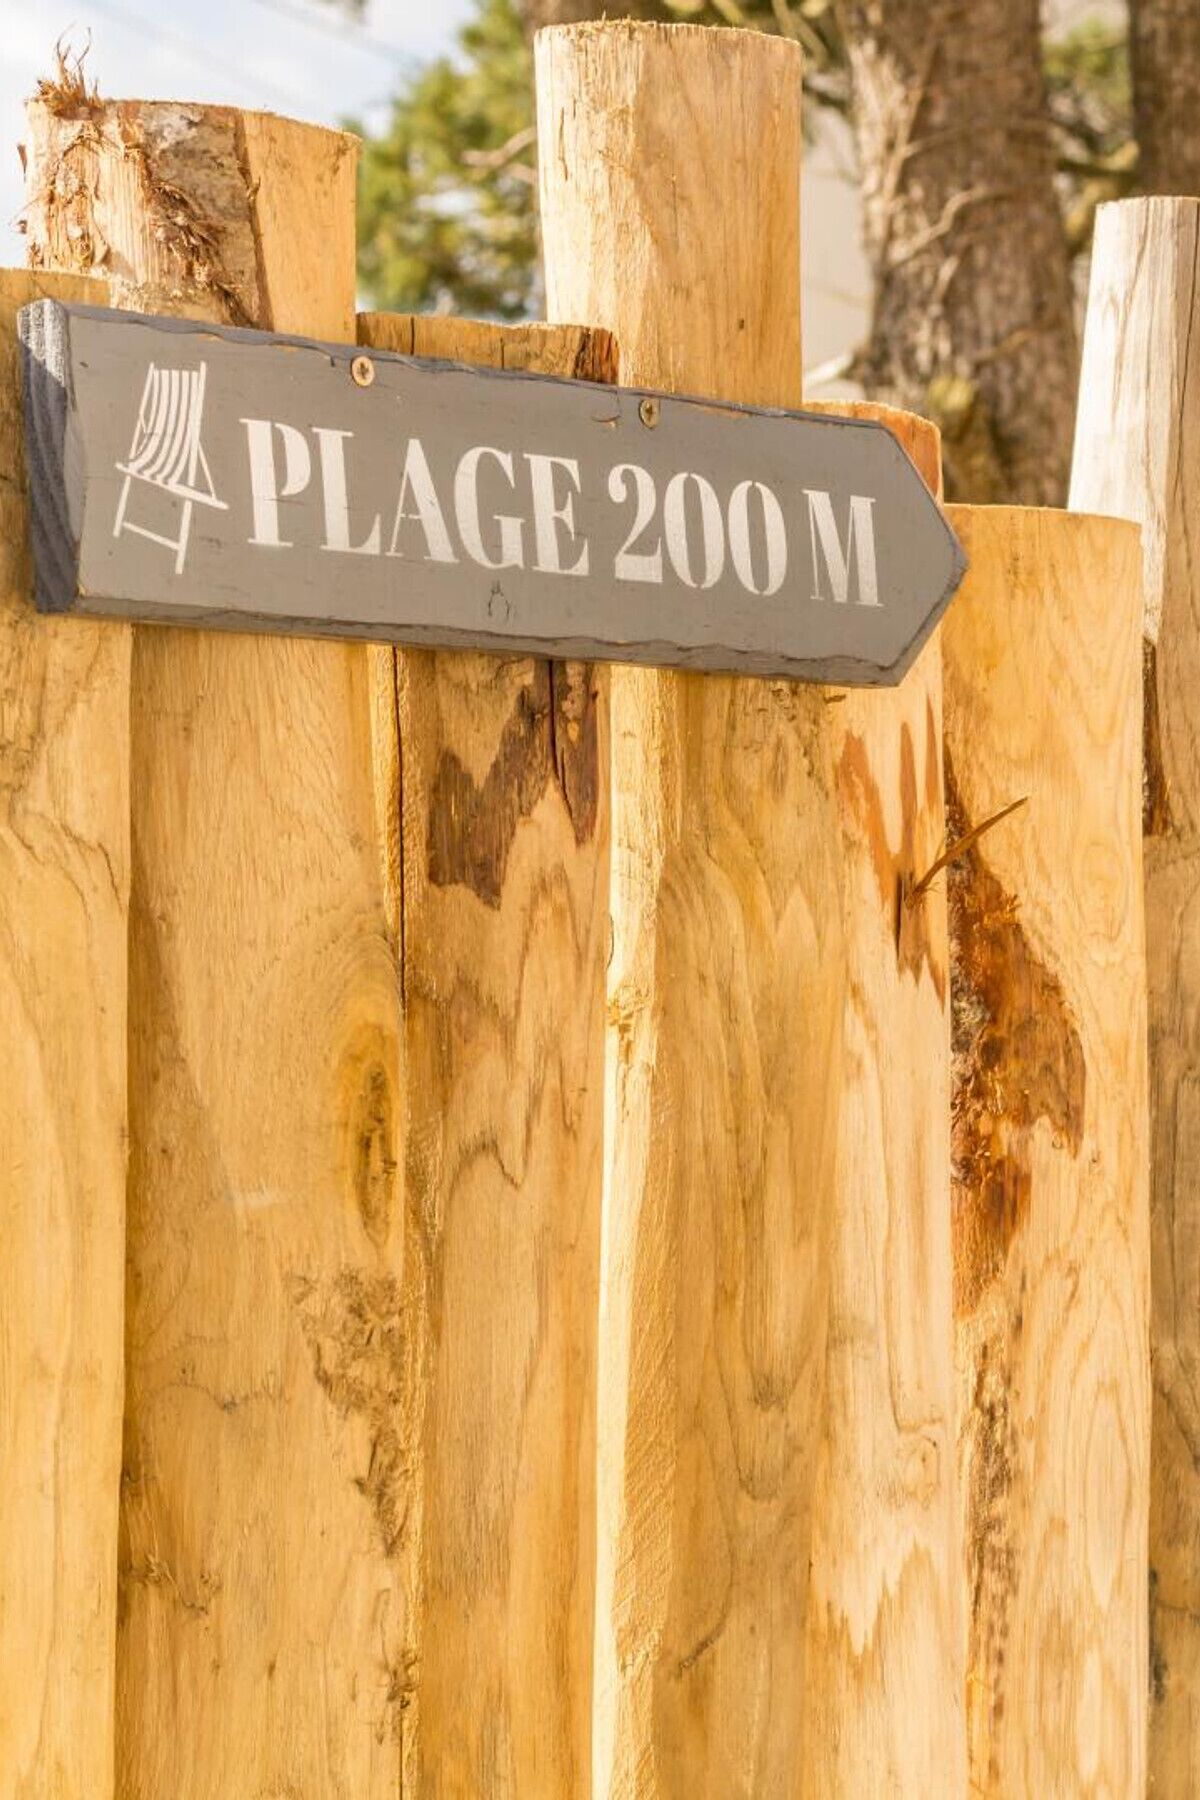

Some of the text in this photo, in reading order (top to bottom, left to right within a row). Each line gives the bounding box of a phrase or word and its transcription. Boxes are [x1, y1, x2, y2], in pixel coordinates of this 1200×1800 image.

[238, 416, 884, 608] PLAGE 200 M
